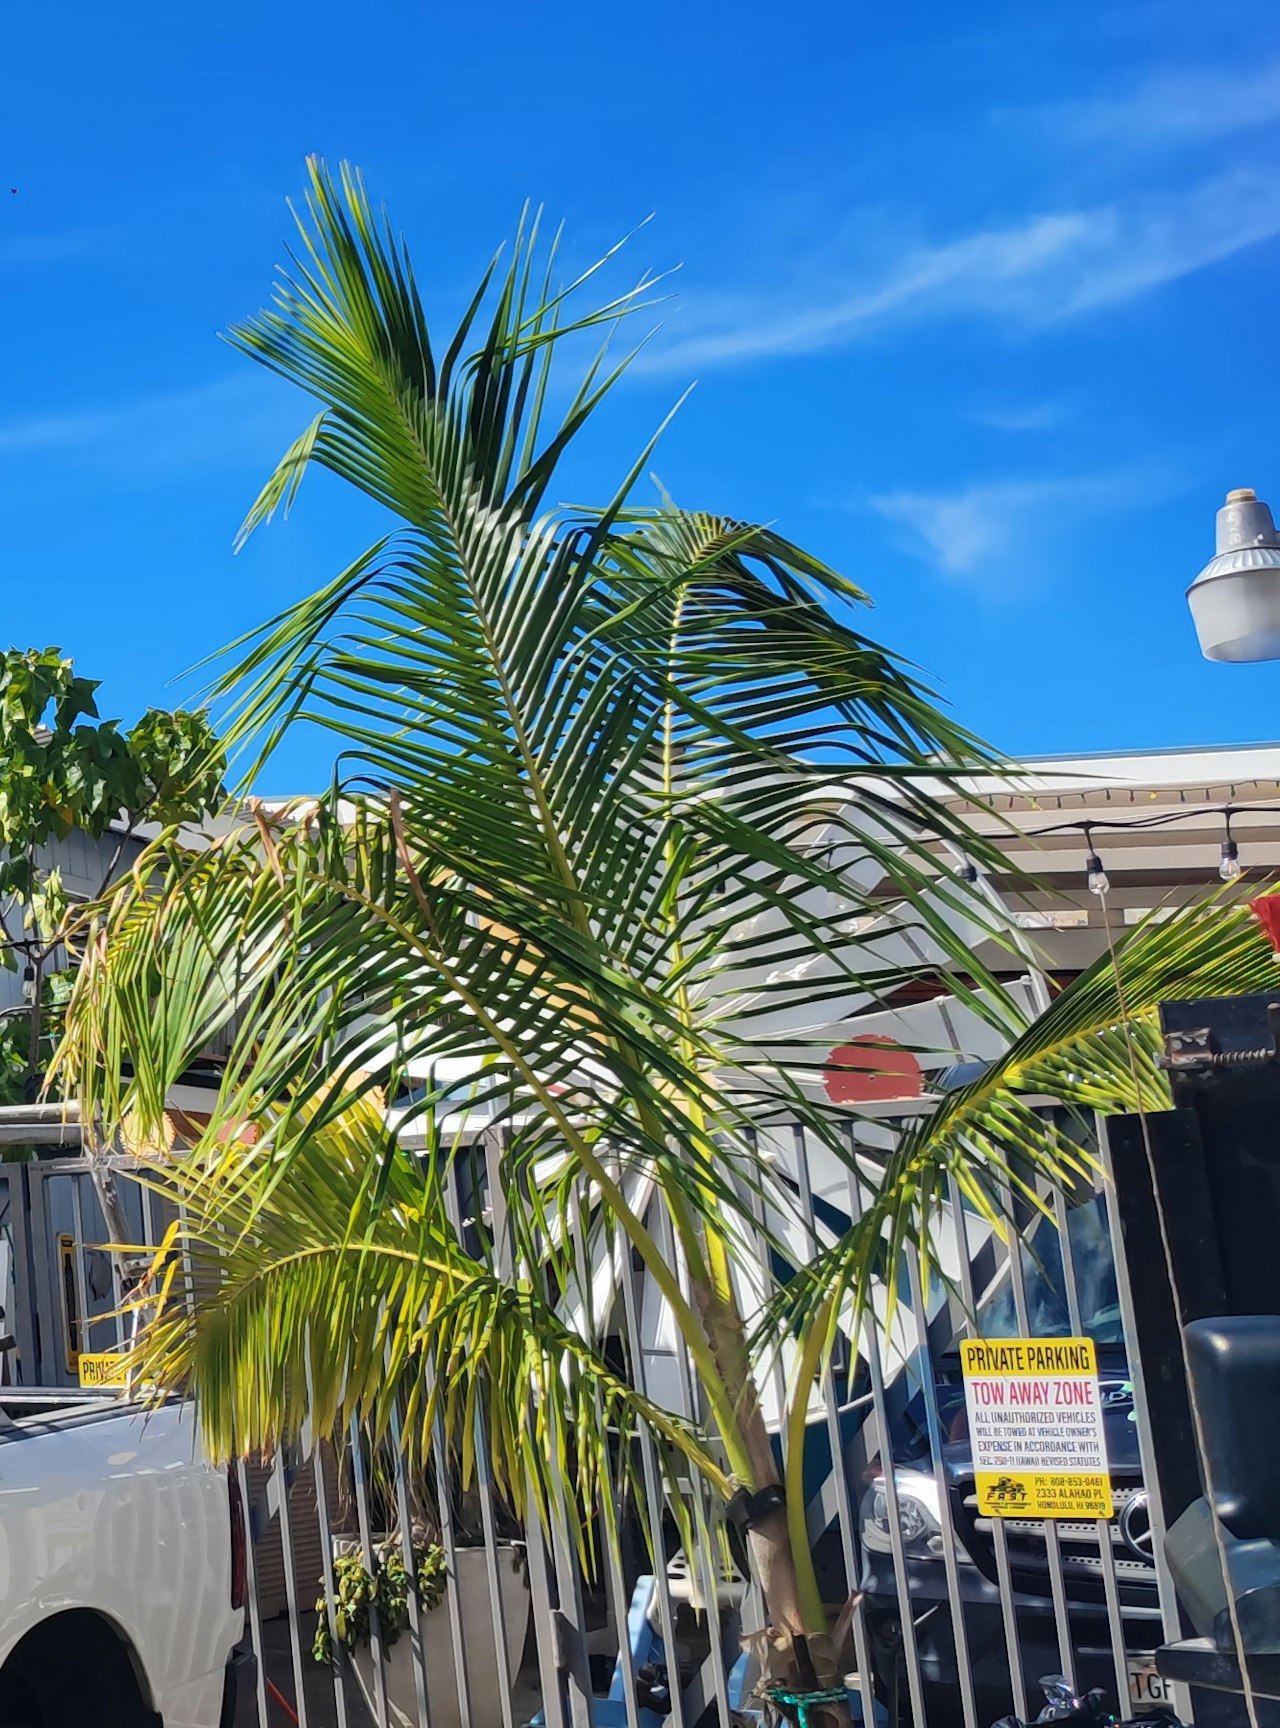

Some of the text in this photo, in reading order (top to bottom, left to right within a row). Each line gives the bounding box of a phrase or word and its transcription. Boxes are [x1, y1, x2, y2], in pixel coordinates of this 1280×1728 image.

[967, 1346, 1090, 1371] PRIVATE PARKING
[971, 1382, 1004, 1405] TOW
[1010, 1382, 1049, 1405] AWAY
[1053, 1381, 1094, 1405] ZONE
[975, 1411, 1096, 1424] ALL UNAUTHORIZED VEHICLES
[975, 1427, 1097, 1438] WILL BE TOWED AT VEHICLE OWNER'S
[978, 1440, 1100, 1453] EXPENSE IN ACCORDANCE WITH
[1041, 1456, 1068, 1467] REVISED
[1068, 1456, 1101, 1467] STATUTES
[1034, 1477, 1047, 1486] PH:
[1036, 1488, 1104, 1499] 2333 ALAHAO PL
